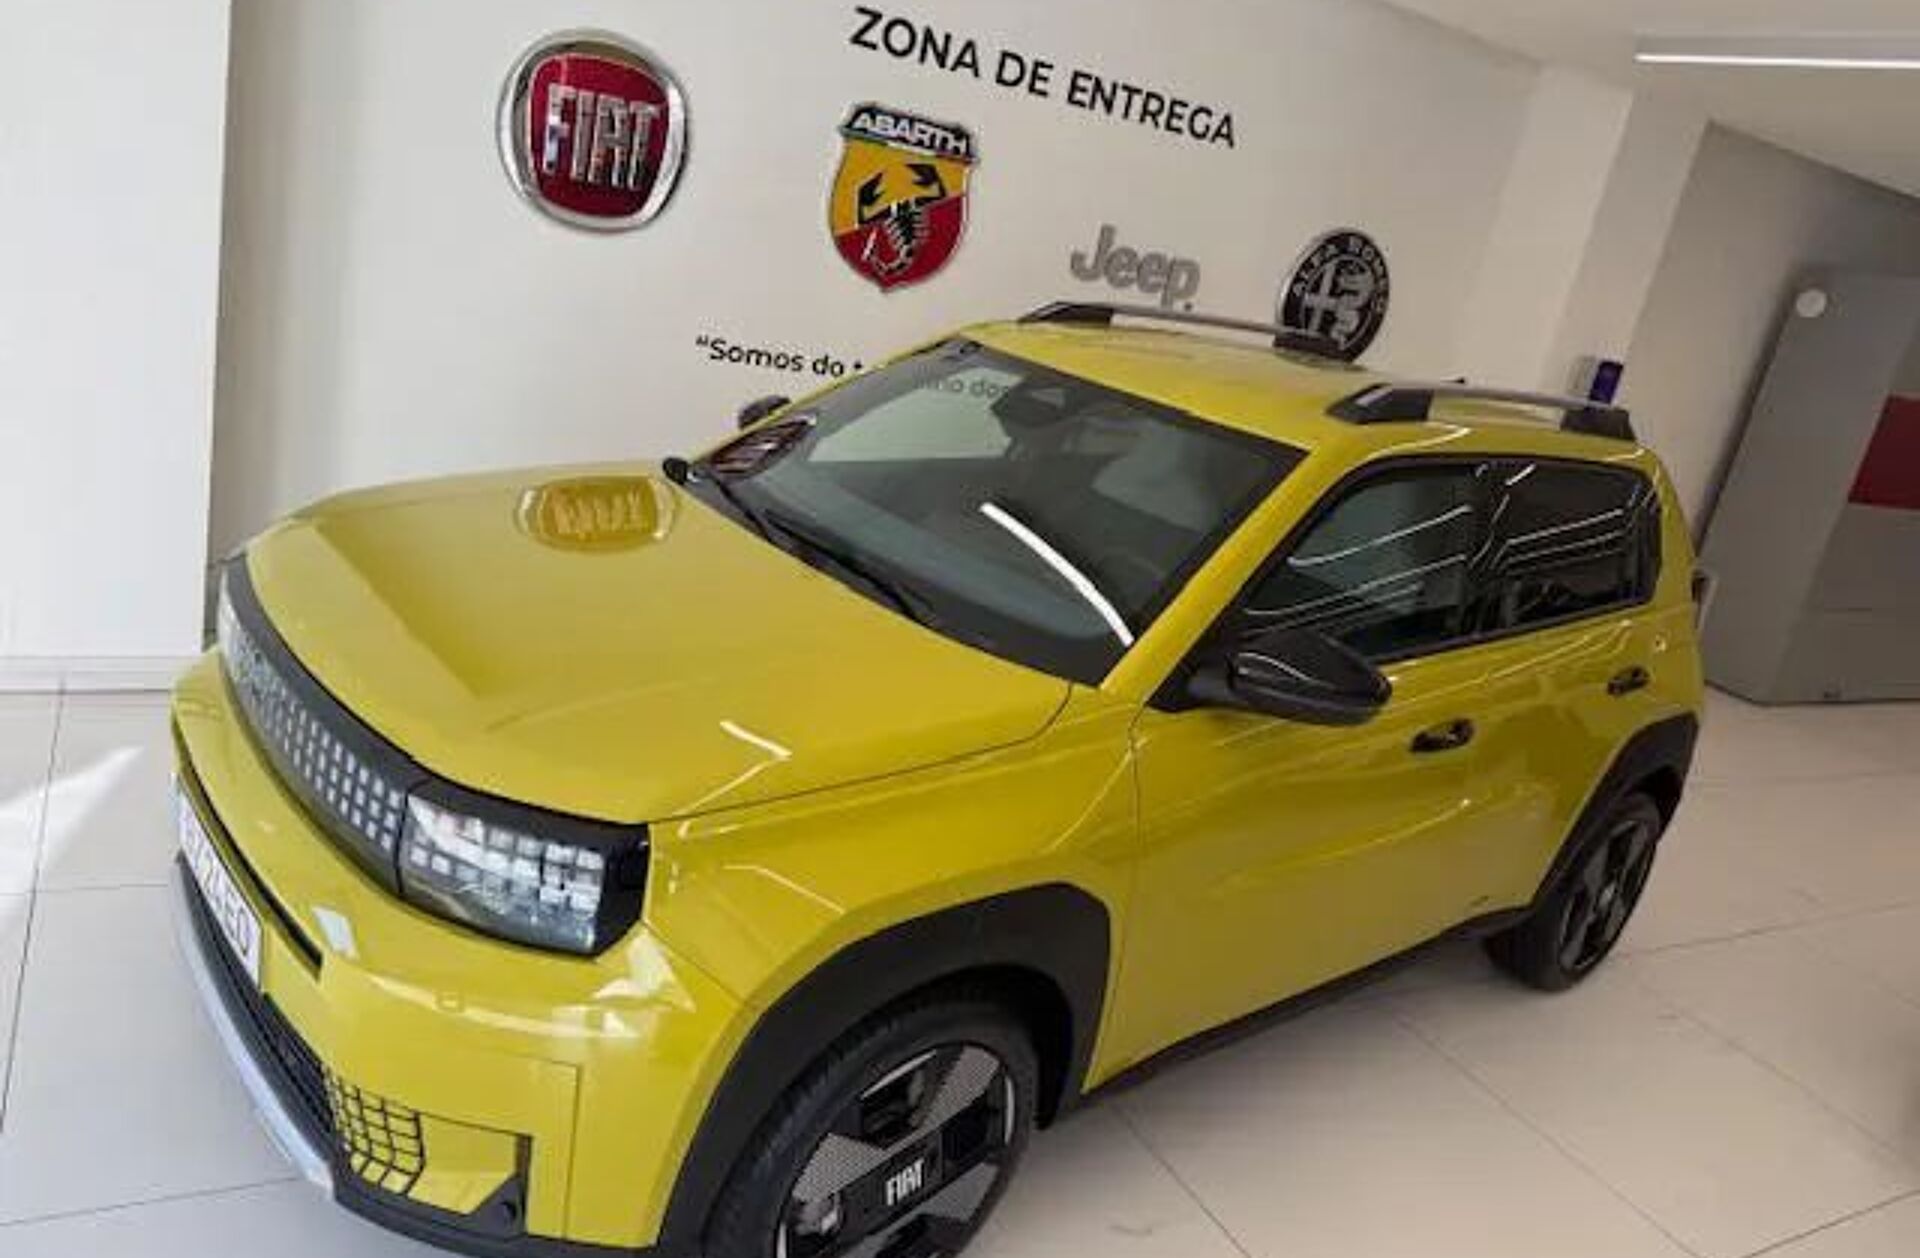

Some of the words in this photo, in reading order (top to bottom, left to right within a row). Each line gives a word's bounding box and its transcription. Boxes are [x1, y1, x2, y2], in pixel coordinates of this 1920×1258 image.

[850, 6, 981, 79] ZONA
[994, 50, 1055, 97] DE
[1066, 71, 1236, 149] ENTREGA
[543, 82, 662, 192] FIAT
[851, 111, 967, 156] ABARTH
[1070, 224, 1200, 307] Jeep
[812, 353, 844, 377] do
[886, 1157, 925, 1206] FIAT
